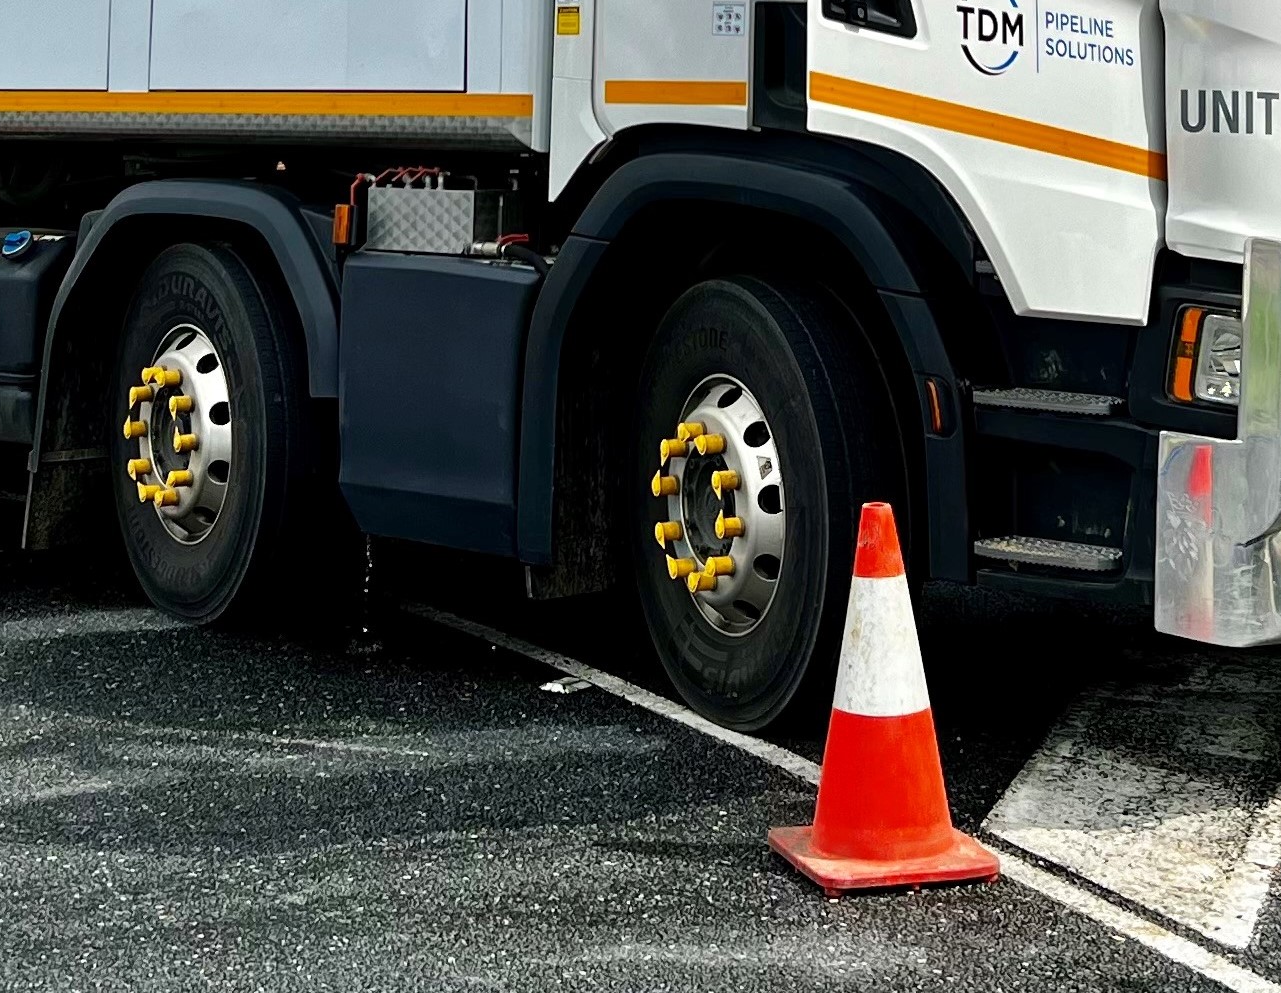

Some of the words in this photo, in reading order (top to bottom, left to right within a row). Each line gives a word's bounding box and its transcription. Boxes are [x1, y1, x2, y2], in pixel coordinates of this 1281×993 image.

[956, 5, 1024, 47] TDM
[1045, 11, 1114, 39] PIPELINE
[1045, 38, 1134, 67] SOLUTIONS
[1180, 88, 1280, 136] UNIT
